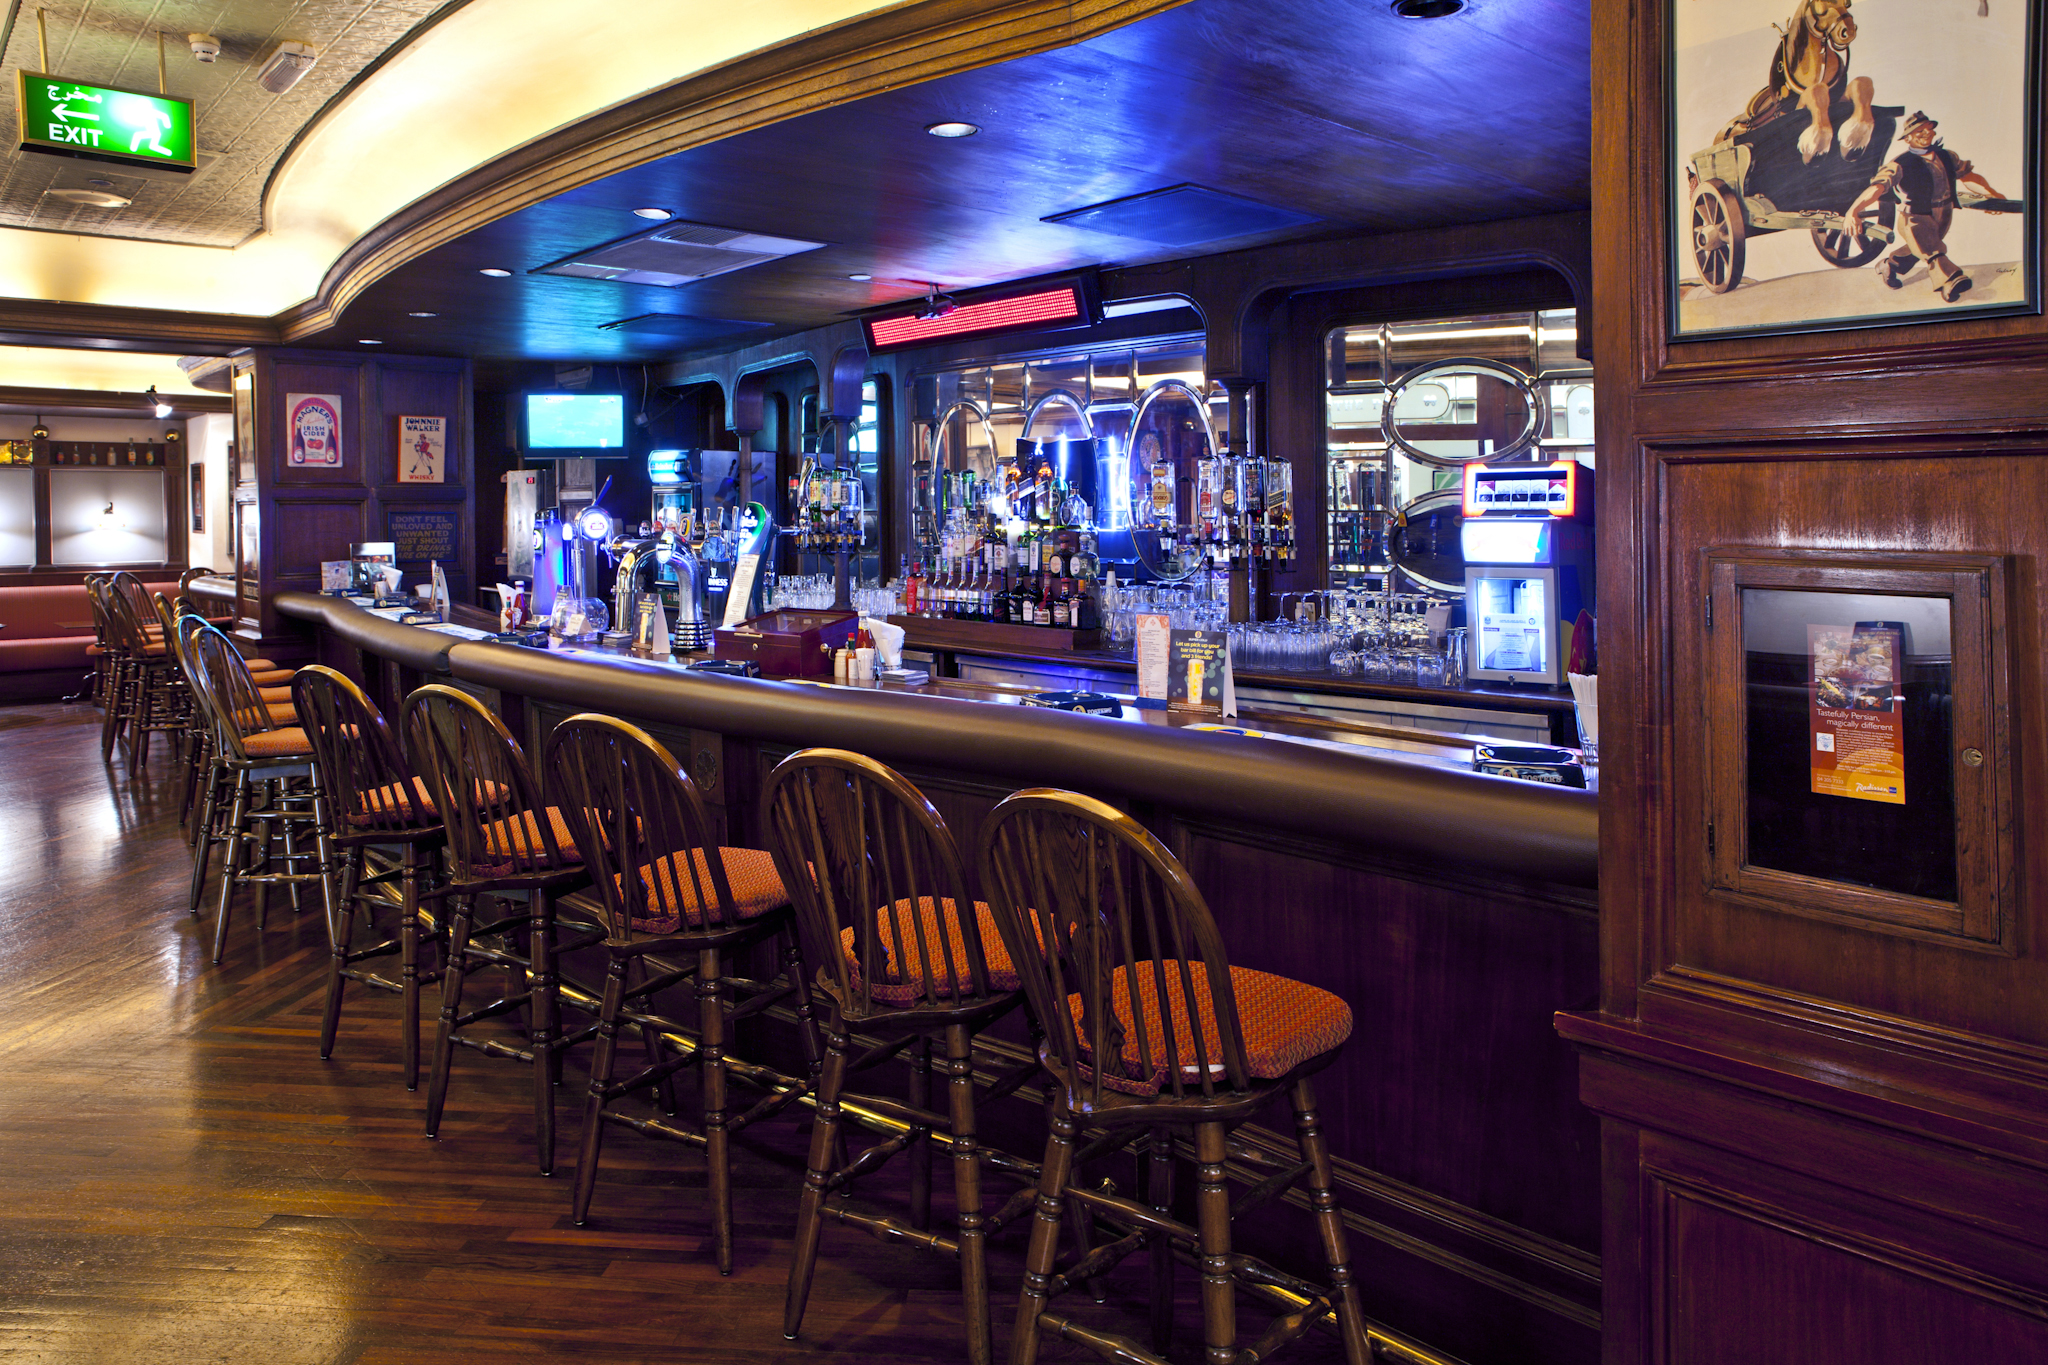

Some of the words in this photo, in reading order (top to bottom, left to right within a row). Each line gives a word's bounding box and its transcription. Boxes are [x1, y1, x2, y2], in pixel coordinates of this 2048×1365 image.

[47, 85, 103, 104] مخرج
[49, 123, 103, 147] EXIT
[396, 537, 418, 545] JUST
[420, 537, 449, 545] SHOUT
[1559, 531, 1576, 550] Red
[416, 544, 452, 552] DRINKS
[415, 551, 430, 559] ON
[1816, 708, 1849, 720] Tastefully
[1851, 711, 1880, 722] Persian,
[1826, 719, 1859, 729] magically
[1861, 721, 1894, 731] different
[1855, 782, 1889, 793] Radisson
